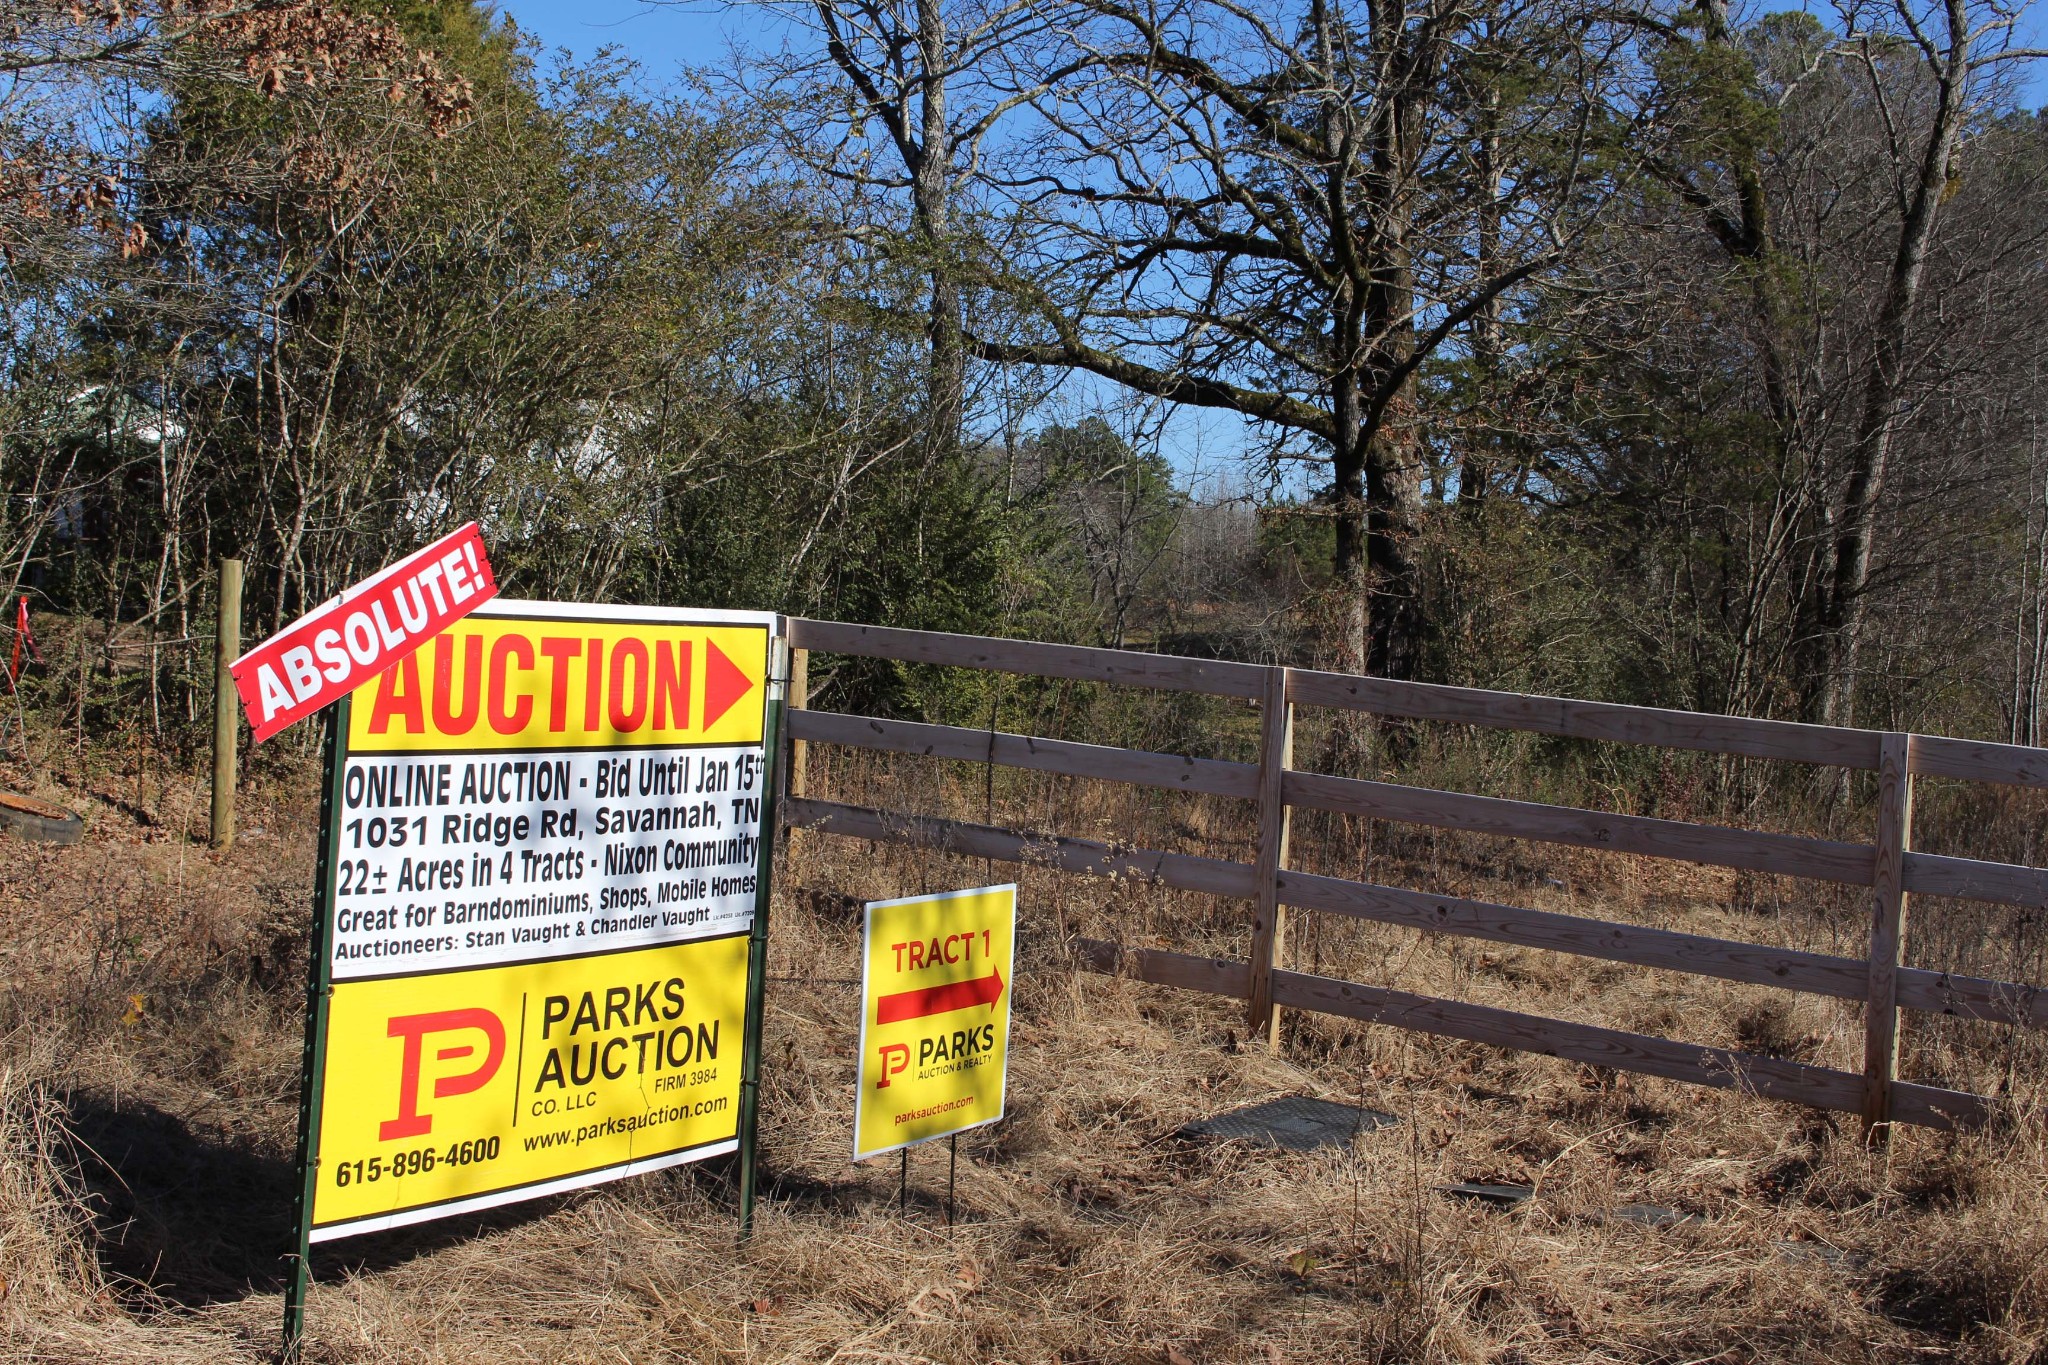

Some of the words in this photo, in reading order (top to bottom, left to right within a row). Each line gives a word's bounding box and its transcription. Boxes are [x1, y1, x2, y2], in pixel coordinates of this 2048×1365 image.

[257, 540, 487, 722] ABSOLUTE!
[367, 633, 693, 735] AUCTION
[345, 764, 451, 809] ONLINE
[459, 760, 571, 804] AUCTION
[596, 758, 631, 798] Bid
[639, 756, 690, 796] Until
[696, 756, 729, 793] Jan
[346, 815, 427, 849] 1031
[442, 812, 530, 847] Ridge
[540, 808, 584, 841] Rd,
[595, 800, 722, 835] Savannah,
[732, 797, 760, 825] TN
[338, 858, 388, 896] 22±
[397, 857, 464, 892] Acres
[471, 852, 492, 887] in
[500, 851, 513, 885] 4
[521, 846, 585, 883] Tracts
[604, 842, 658, 876] Nixon
[663, 832, 759, 871] Community
[337, 905, 398, 933] Great
[405, 903, 437, 928] for
[444, 892, 593, 925] Barndominiums,
[600, 886, 651, 912] Shops,
[657, 878, 706, 904] Mobile
[711, 874, 756, 898] Homes
[335, 936, 459, 960] Auctioneers:
[466, 930, 505, 949] Stan
[512, 923, 570, 944] Vaught
[575, 920, 586, 936] &
[591, 912, 658, 935] Chandler
[662, 906, 710, 926] Vaught
[892, 932, 975, 973] TRACT
[982, 929, 990, 957] 1
[542, 977, 685, 1040] PARKS
[534, 1020, 720, 1094] AUCTION
[918, 1063, 954, 1080] AUCTION
[956, 1061, 961, 1071] &
[963, 1053, 993, 1069] REALTY
[919, 1023, 994, 1067] PARKS
[531, 1099, 561, 1117] CO.
[566, 1091, 597, 1112] LLC
[655, 1073, 686, 1094] FIRM
[690, 1068, 718, 1087] 3984
[523, 1096, 728, 1152] www.parksauction.com
[895, 1096, 974, 1126] parksauction.com
[336, 1136, 500, 1187] 615-896-4600
